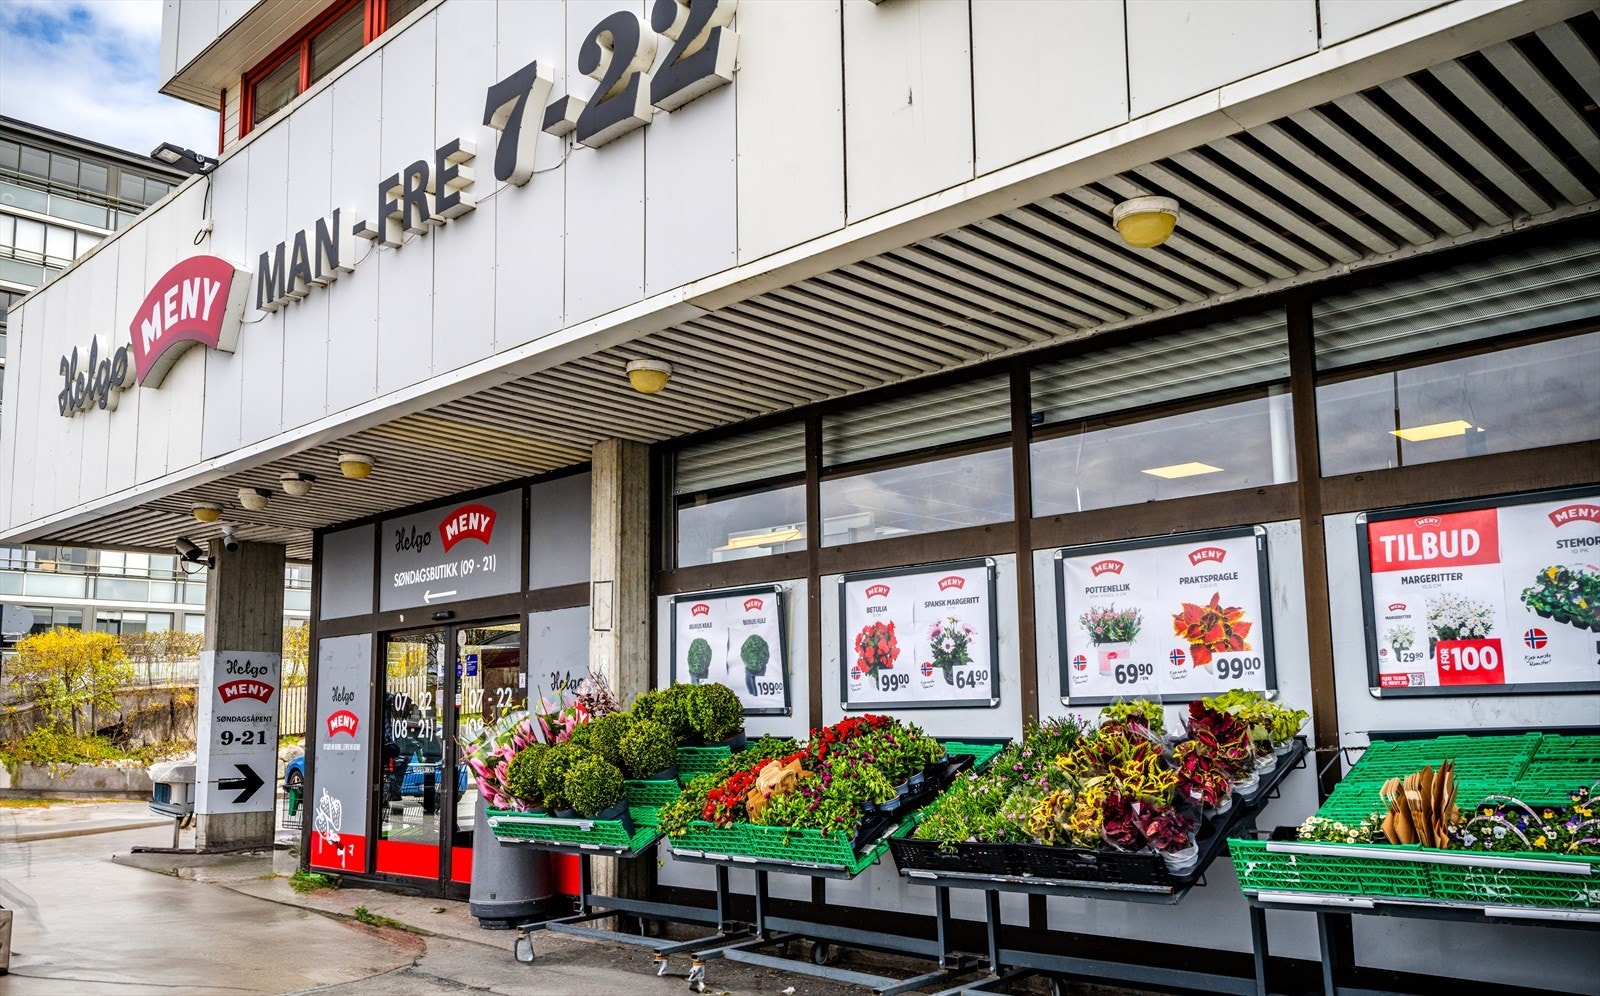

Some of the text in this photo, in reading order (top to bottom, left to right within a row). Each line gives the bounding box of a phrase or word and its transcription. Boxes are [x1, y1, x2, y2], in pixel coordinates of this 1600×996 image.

[255, 207, 343, 311] MAN
[377, 137, 467, 247] FRE
[140, 276, 221, 356] MENY
[1417, 517, 1439, 525] MENY
[1554, 508, 1600, 522] MENY
[445, 512, 490, 541] MENY
[1379, 528, 1481, 563] TILBUD
[1192, 550, 1223, 564] MENY
[1094, 562, 1121, 572] MENY
[393, 562, 458, 587] SØNDAGSBUTIKK
[1179, 572, 1239, 585] PRAKTSPRAGLE
[1401, 572, 1463, 586] MARGERITTER
[941, 577, 963, 587] MENY
[1085, 583, 1131, 594] POTTENELLIK
[868, 586, 888, 596] MENY
[924, 596, 980, 608] SPANSK MARGERITT
[866, 605, 888, 614] BETULIA
[1450, 645, 1499, 671] 100
[224, 683, 269, 697] MENY
[394, 691, 408, 711] 07
[469, 688, 485, 709] 07
[496, 687, 513, 708] 22
[216, 714, 273, 723] SØNDAGSÅPENT
[330, 715, 356, 731] MENY
[220, 730, 267, 746] 9-21
